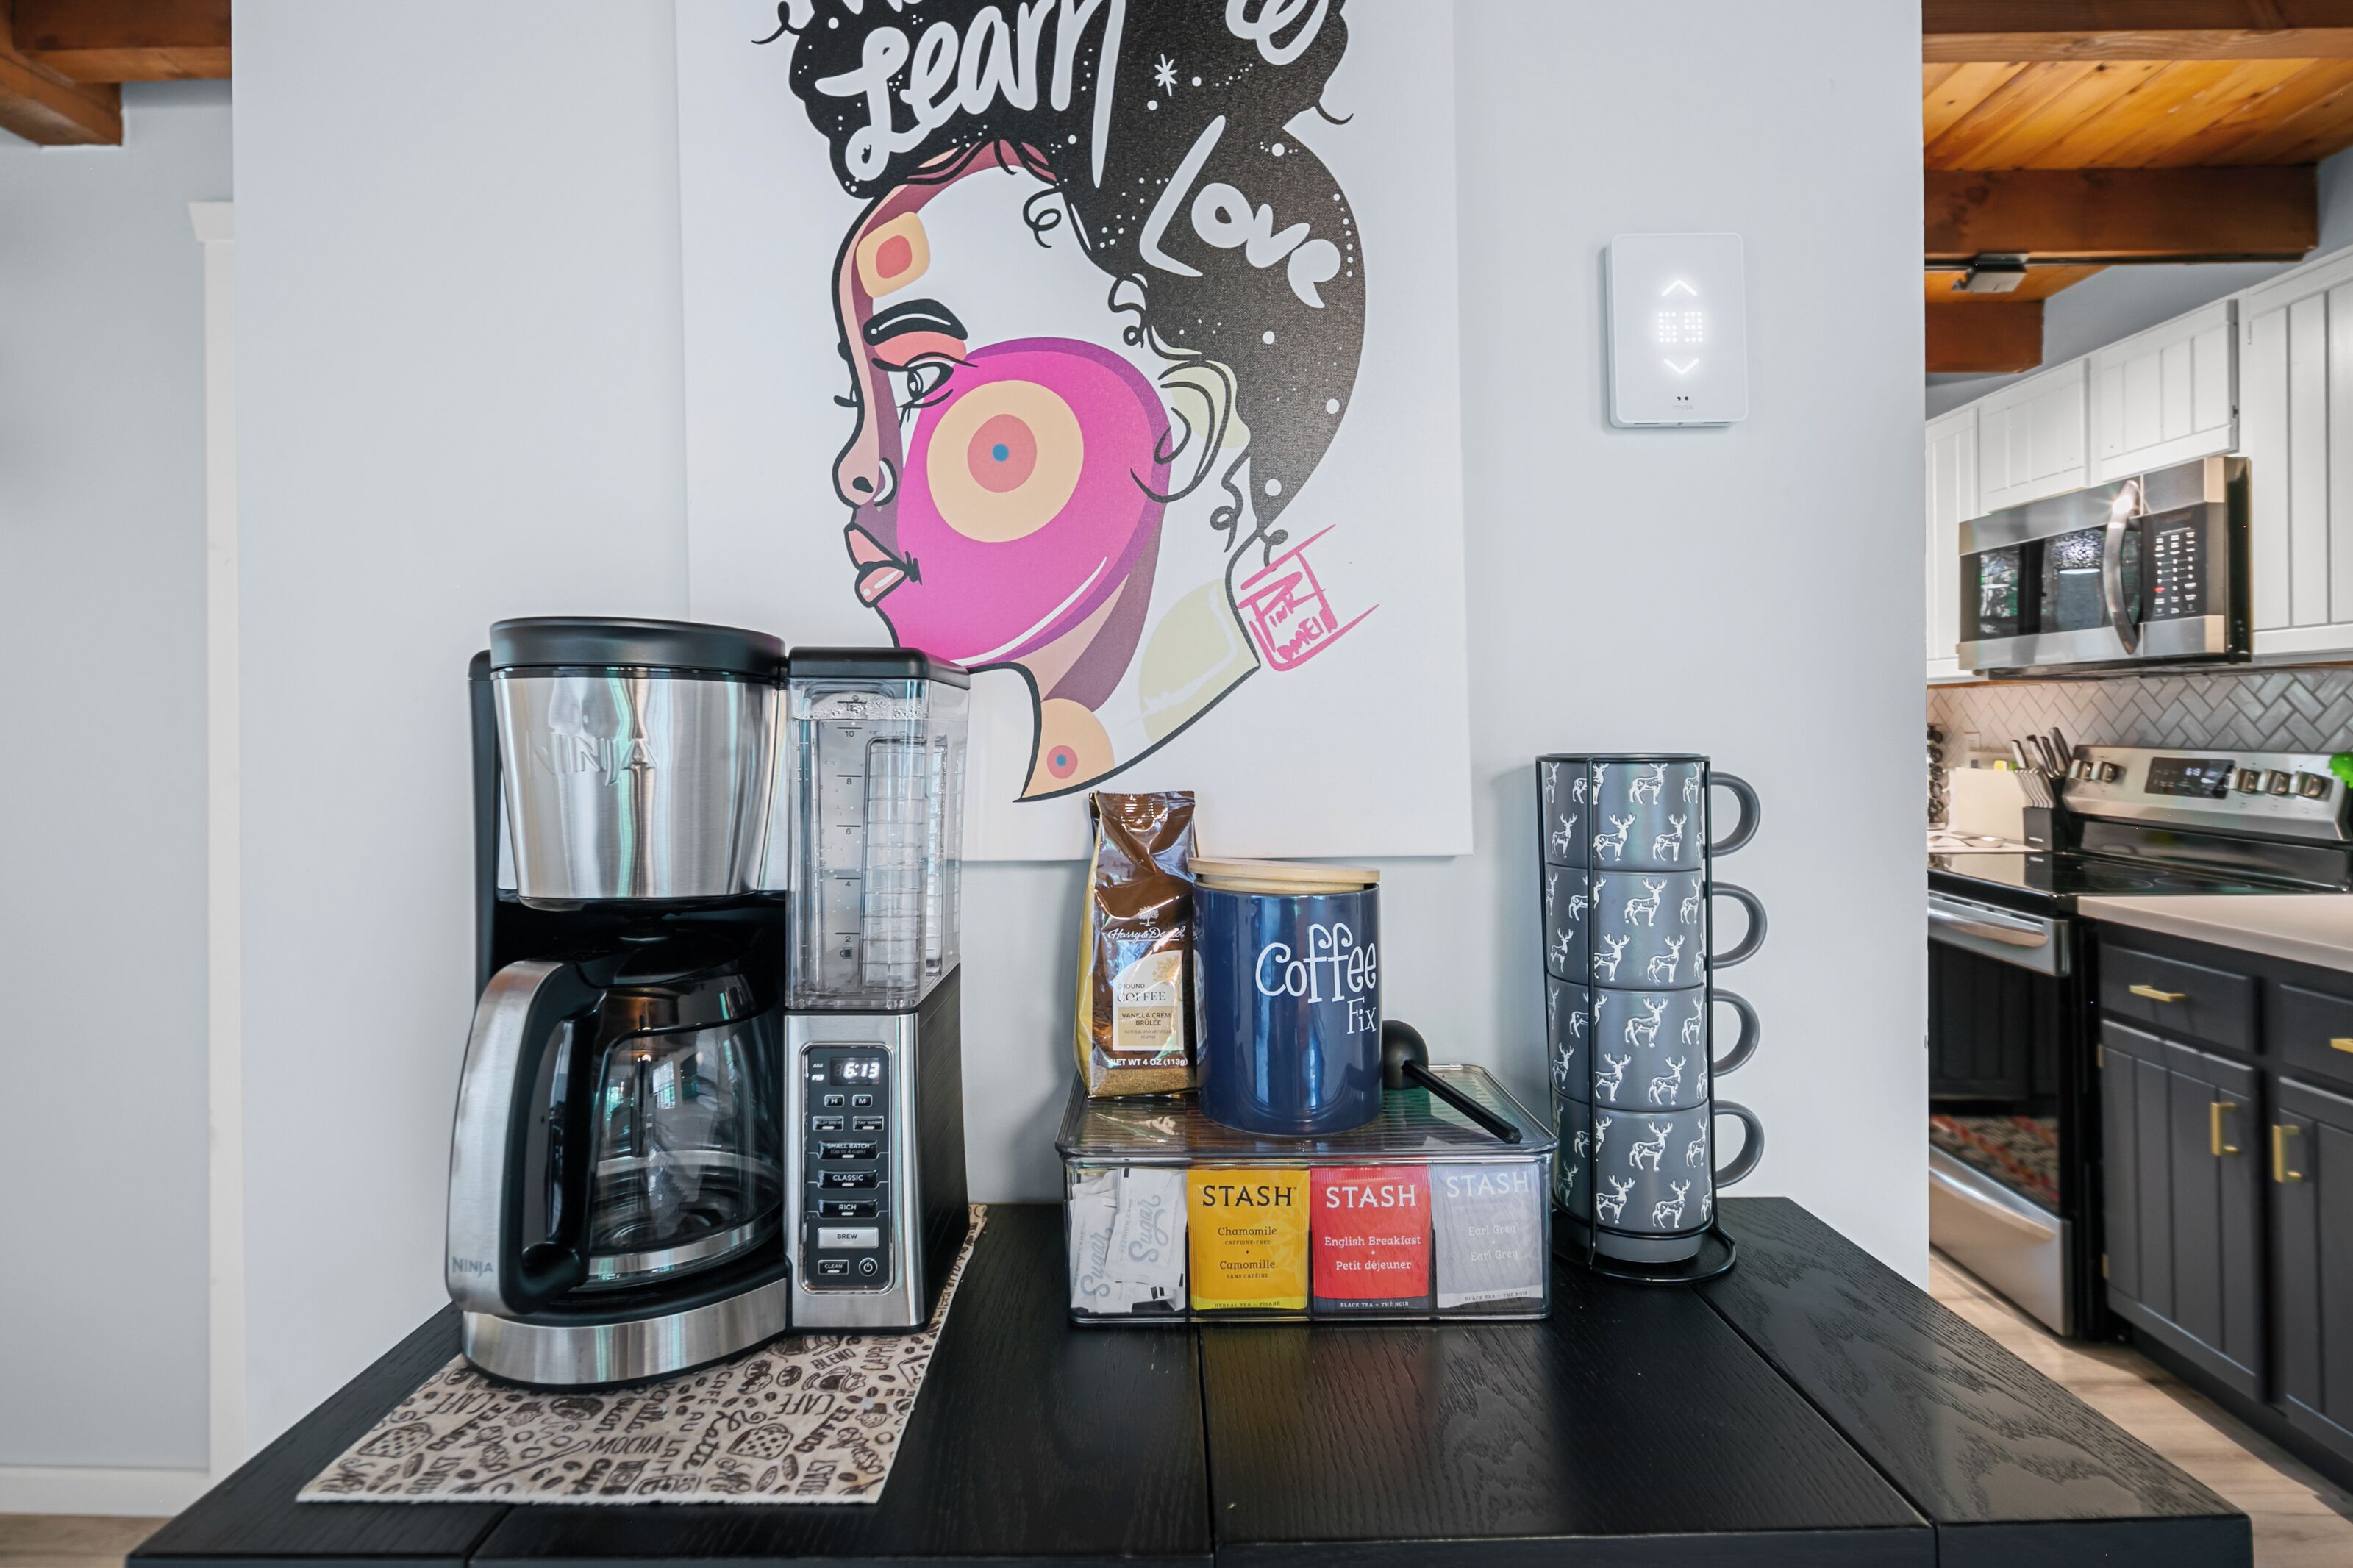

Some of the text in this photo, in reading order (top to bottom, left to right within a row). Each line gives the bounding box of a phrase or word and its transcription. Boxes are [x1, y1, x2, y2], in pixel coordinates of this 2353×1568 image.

[815, 0, 1126, 188] Learn
[1139, 115, 1341, 308] Love
[1658, 312, 1703, 343] 69
[525, 729, 659, 787] NINJA
[1255, 922, 1377, 1004] Coffee
[1346, 996, 1377, 1034] Fix
[843, 1062, 881, 1079] 6:13
[1163, 1058, 1188, 1067] (113g)
[1446, 1170, 1530, 1198] STASH
[1203, 1185, 1292, 1207] STASH
[1326, 1184, 1416, 1208] STASH
[1128, 1195, 1168, 1264] Sugar
[1218, 1226, 1277, 1236] Chamomile
[1324, 1235, 1421, 1248] English Breakfast
[452, 1256, 494, 1278] NINJA
[1219, 1259, 1276, 1270] Camomille
[1335, 1259, 1412, 1272] Petit déjeuner
[589, 1436, 664, 1456] MOCHA
